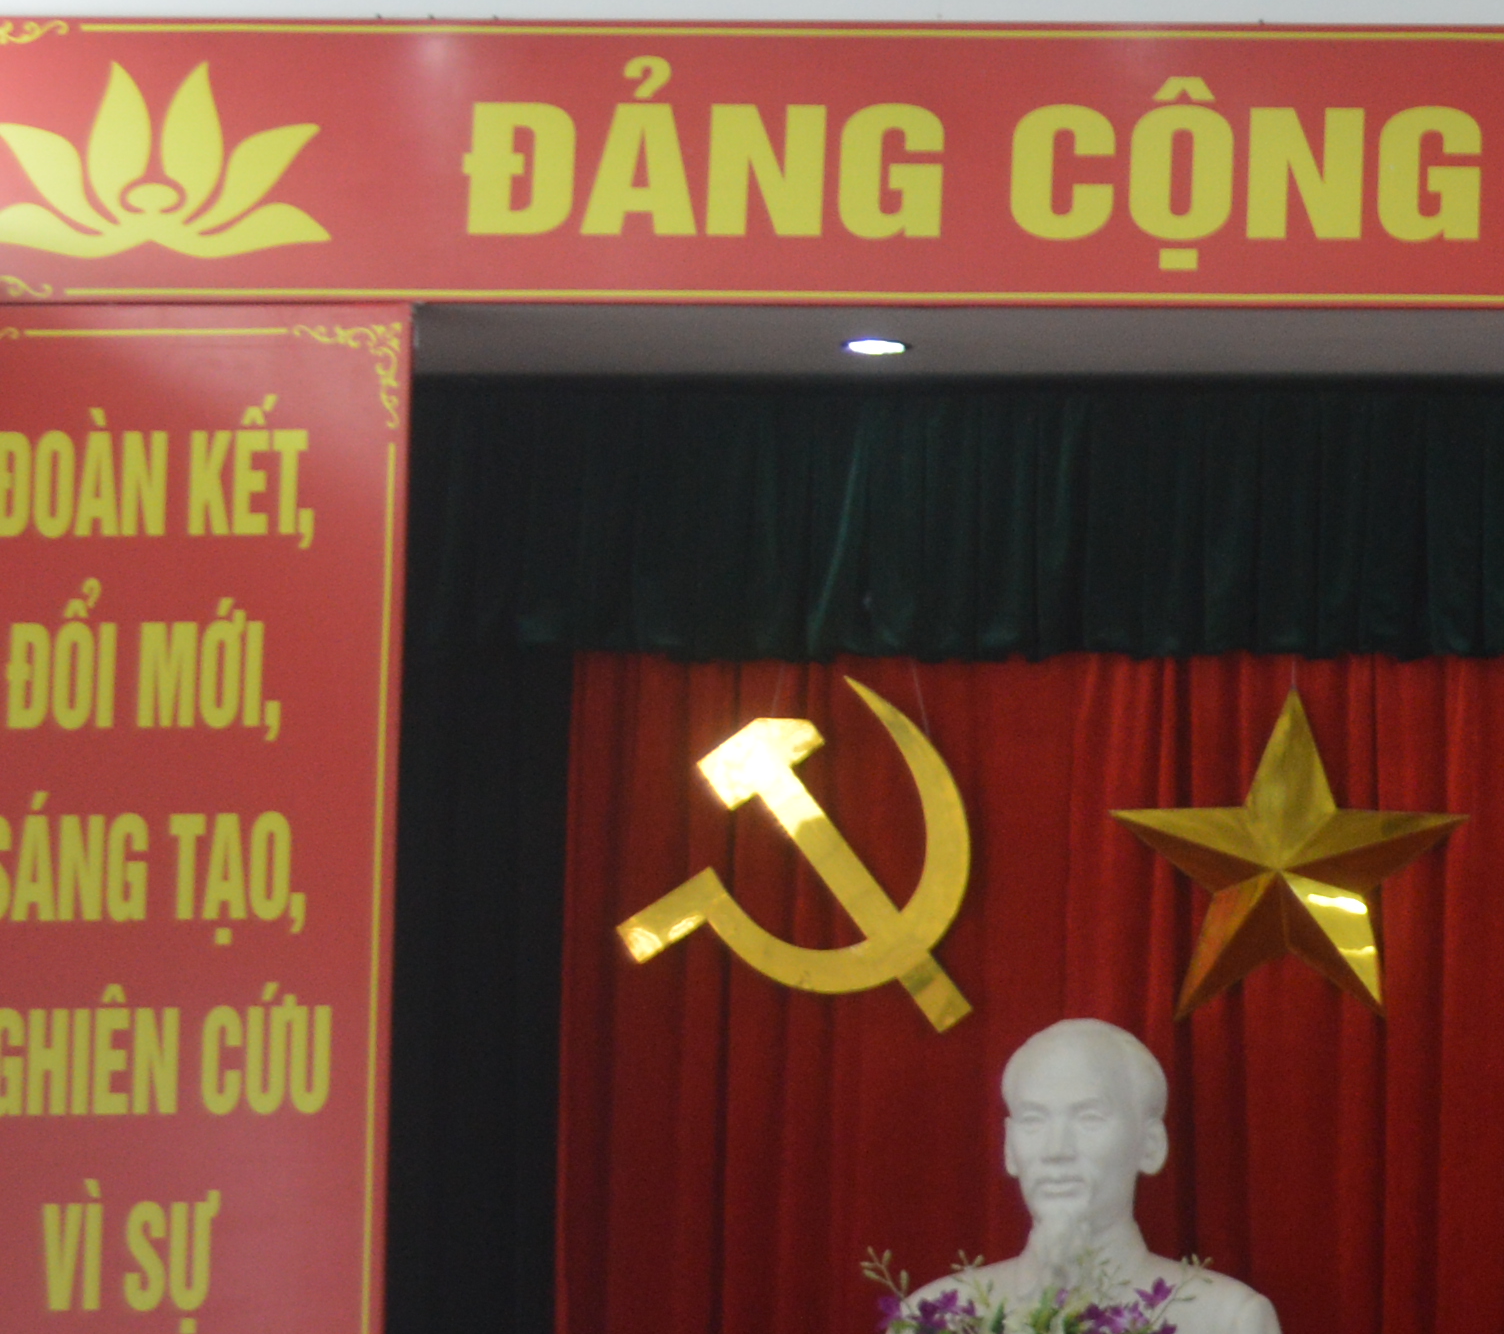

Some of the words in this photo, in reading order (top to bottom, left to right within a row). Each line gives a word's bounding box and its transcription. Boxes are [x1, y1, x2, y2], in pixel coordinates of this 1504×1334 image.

[464, 56, 944, 238] ĐẢNG
[1011, 78, 1482, 270] CỘNG
[189, 395, 314, 548] KẾT,
[7, 579, 117, 730] ĐỔI
[138, 598, 281, 740] MỚI,
[0, 792, 149, 922] ÁNG
[170, 812, 306, 944] TẠO,
[0, 984, 179, 1116] GHIÊN
[202, 983, 331, 1114] CỨU
[44, 1180, 103, 1311] VÌ
[124, 1191, 220, 1334] SỰ
